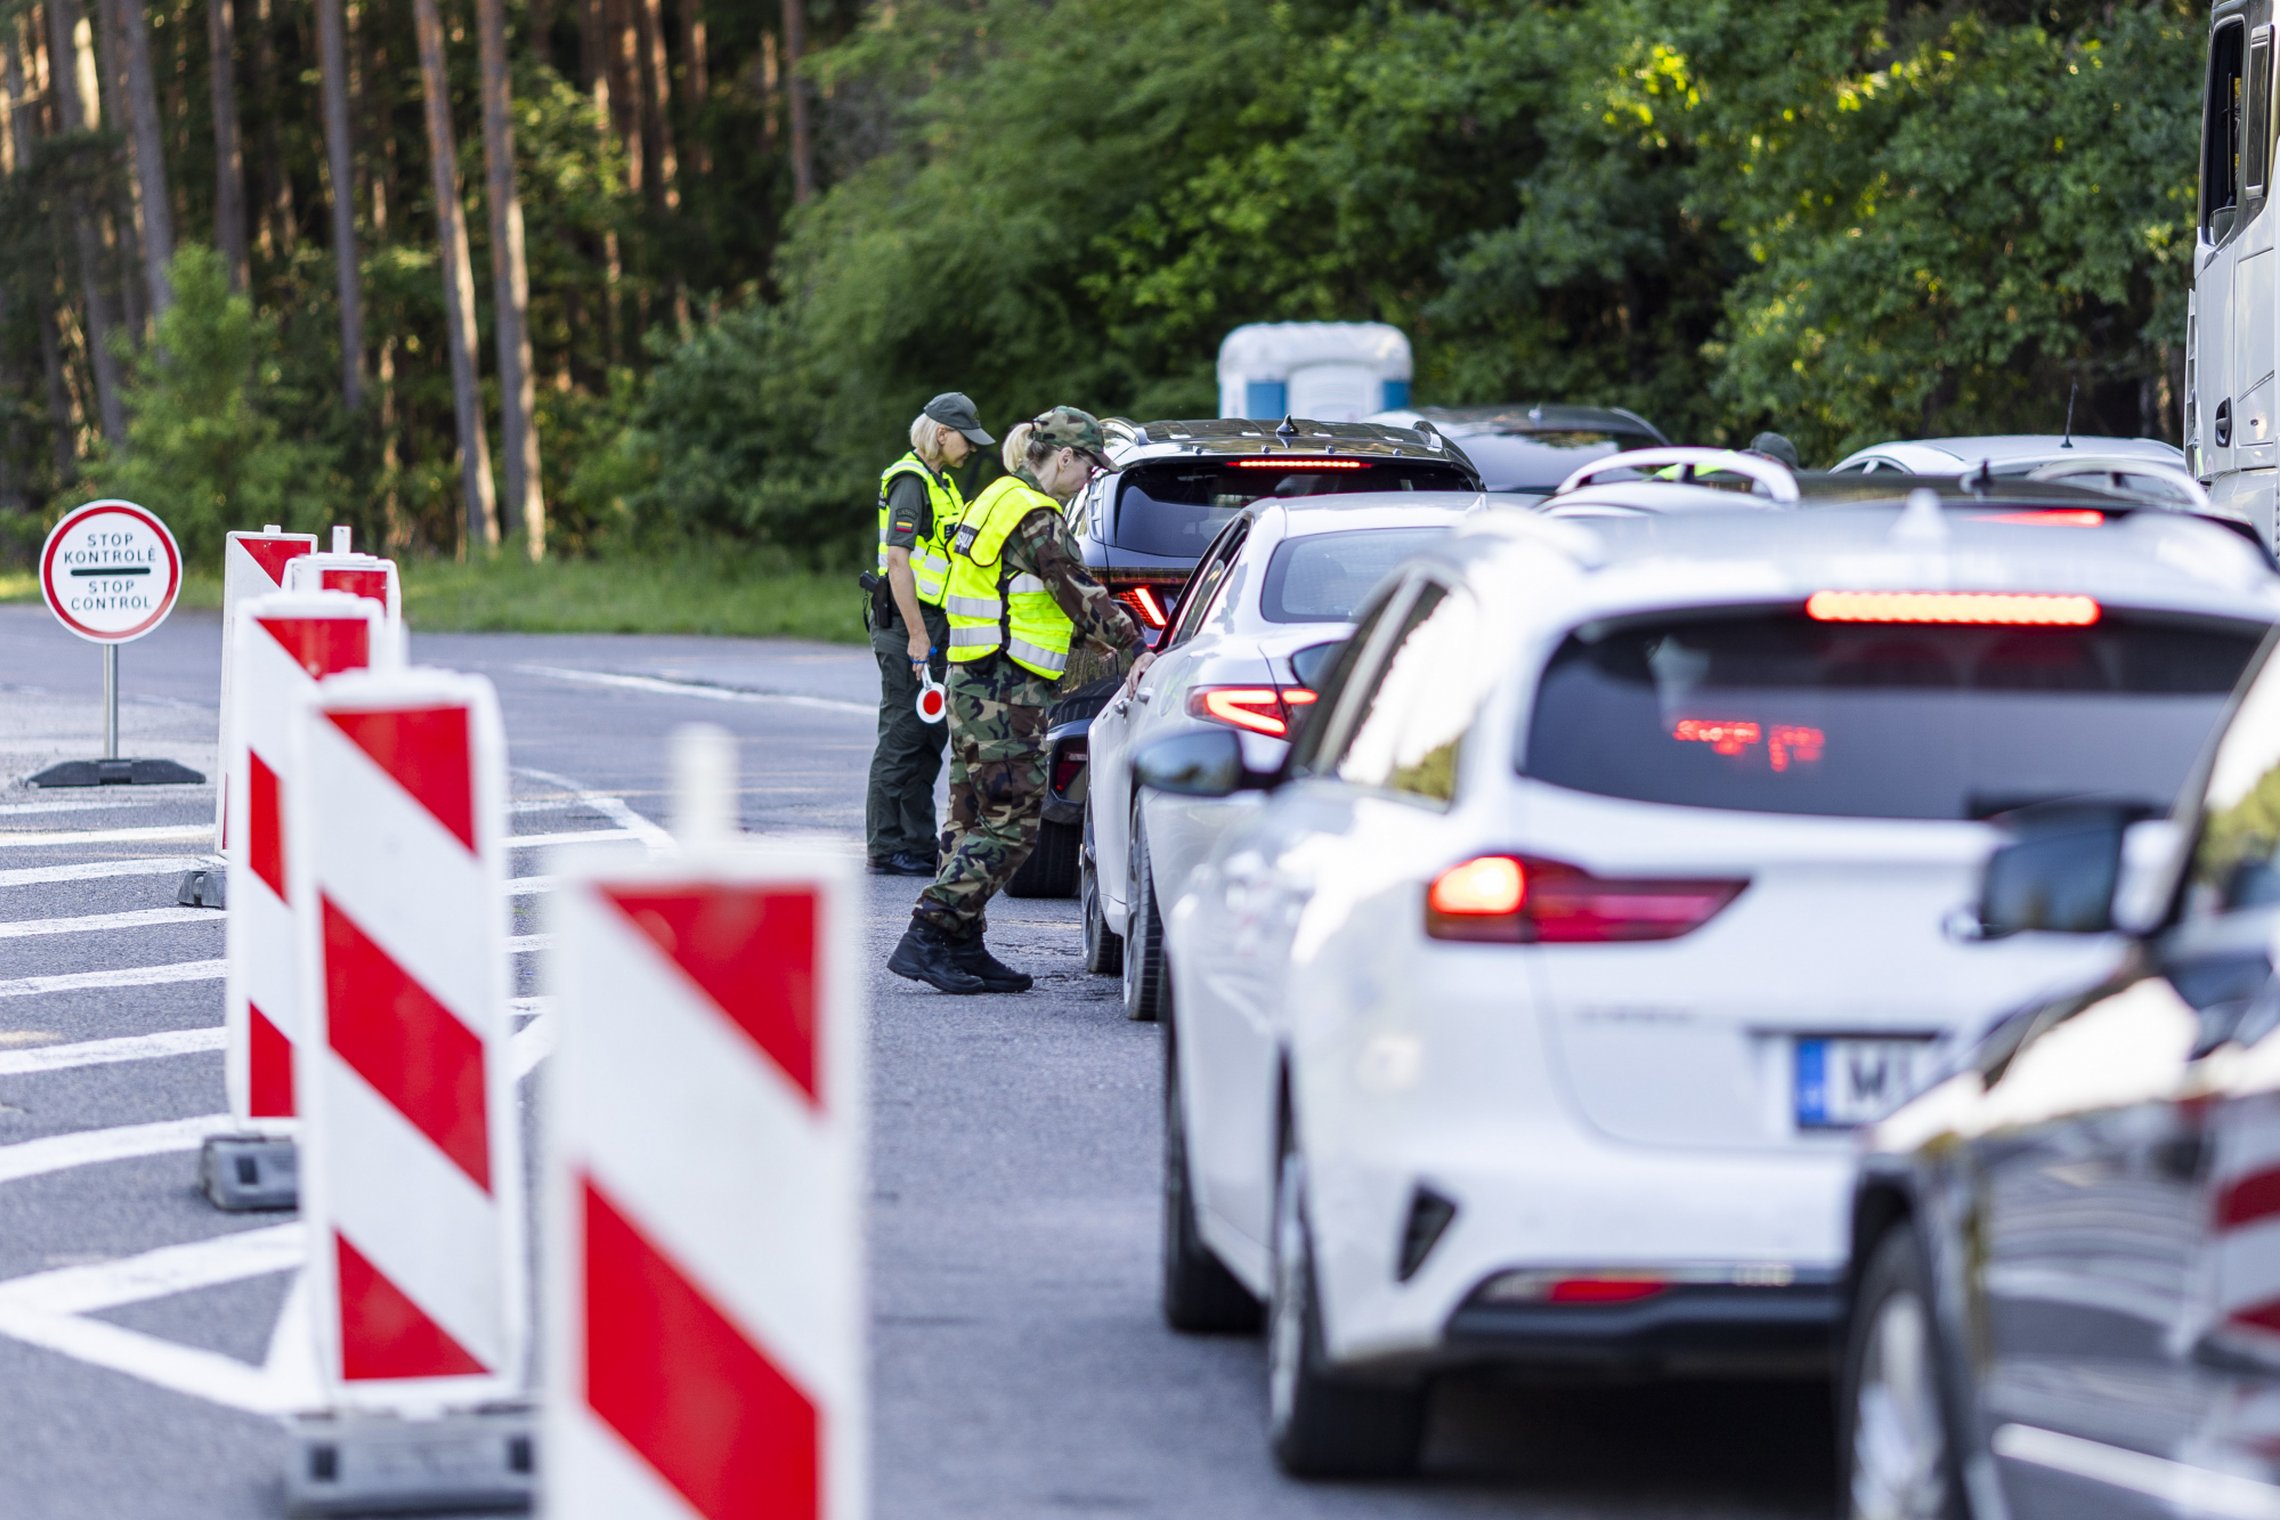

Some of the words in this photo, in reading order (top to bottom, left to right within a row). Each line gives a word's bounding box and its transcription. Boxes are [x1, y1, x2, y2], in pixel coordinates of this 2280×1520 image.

[87, 533, 133, 547] STOP
[64, 545, 156, 564] KONTROLĖ
[88, 580, 134, 594] STOP
[71, 596, 151, 610] CONTROL
